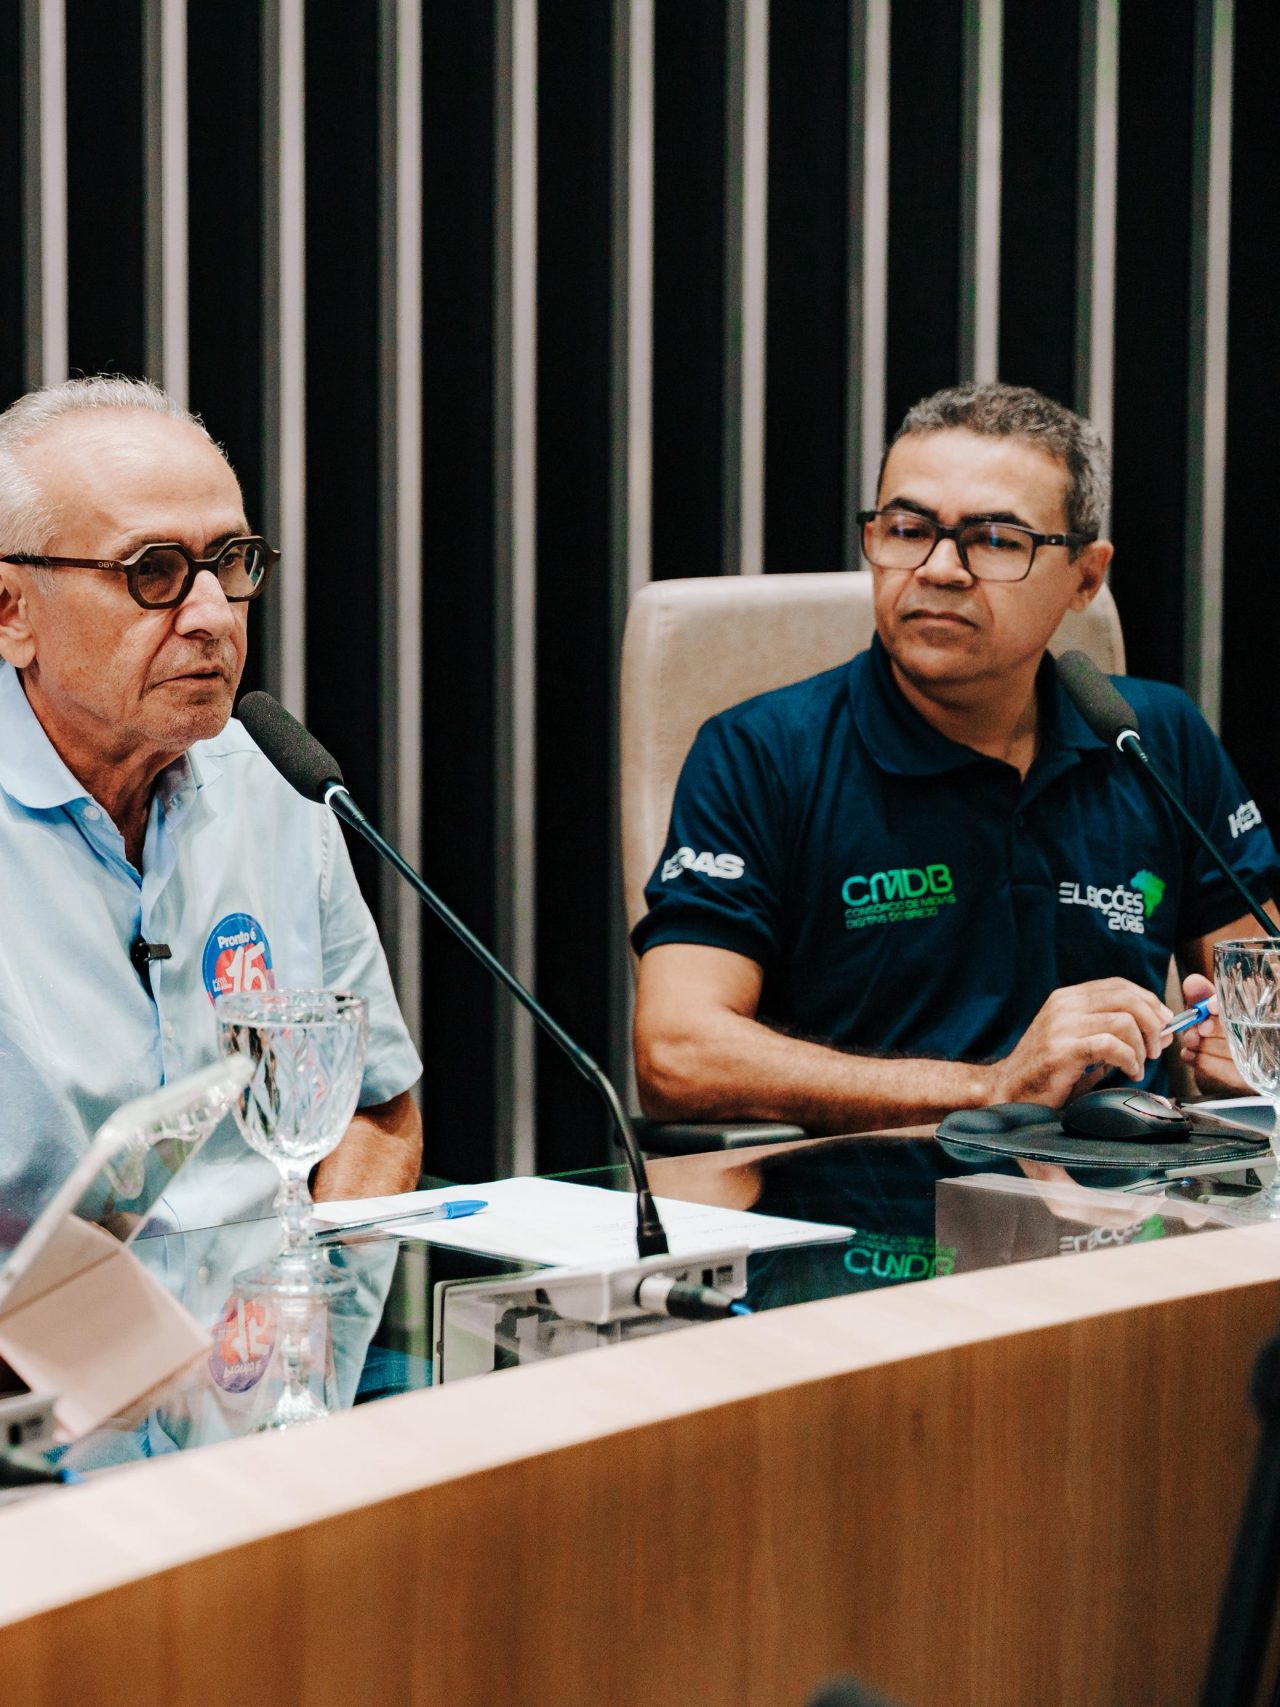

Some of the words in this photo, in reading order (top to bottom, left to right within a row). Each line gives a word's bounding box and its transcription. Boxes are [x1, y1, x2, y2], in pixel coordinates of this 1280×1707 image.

[842, 864, 953, 906] CMDB
[217, 931, 250, 949] Pronto
[225, 941, 267, 993] 15
